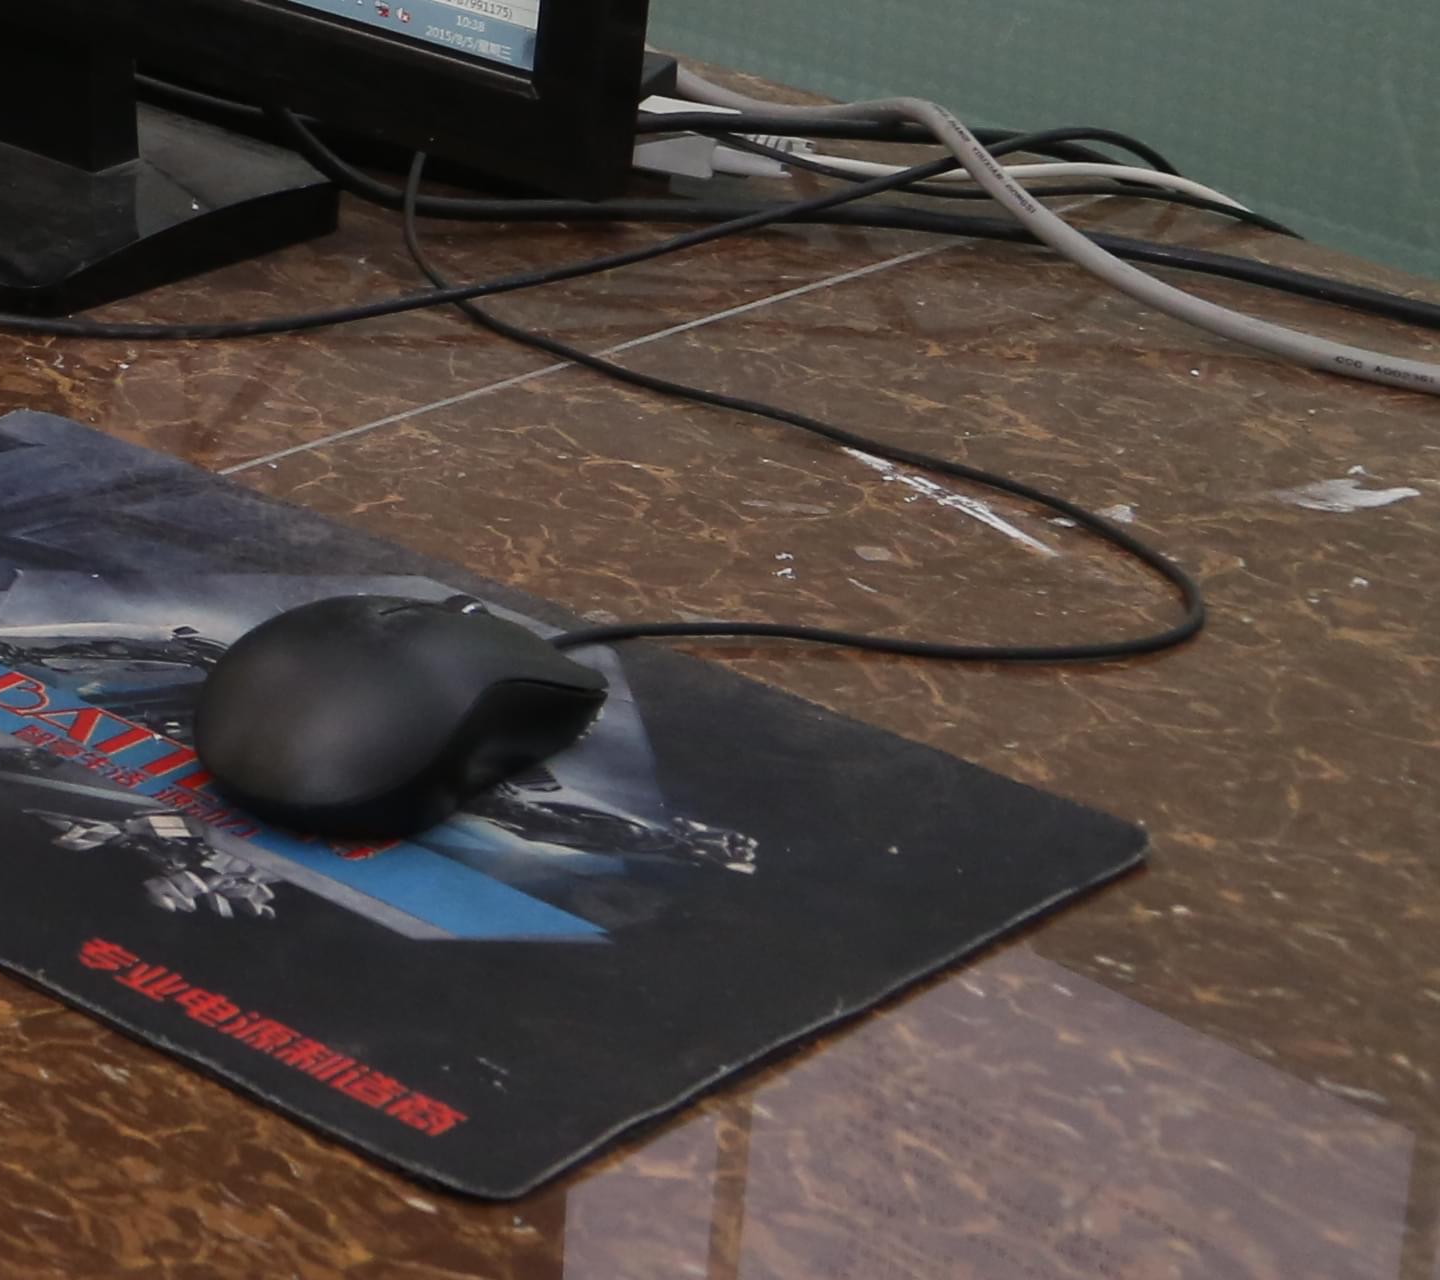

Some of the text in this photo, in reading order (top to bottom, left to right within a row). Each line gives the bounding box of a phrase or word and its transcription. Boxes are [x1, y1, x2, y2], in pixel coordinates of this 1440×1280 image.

[78, 937, 469, 1137] 专业电源制造商
